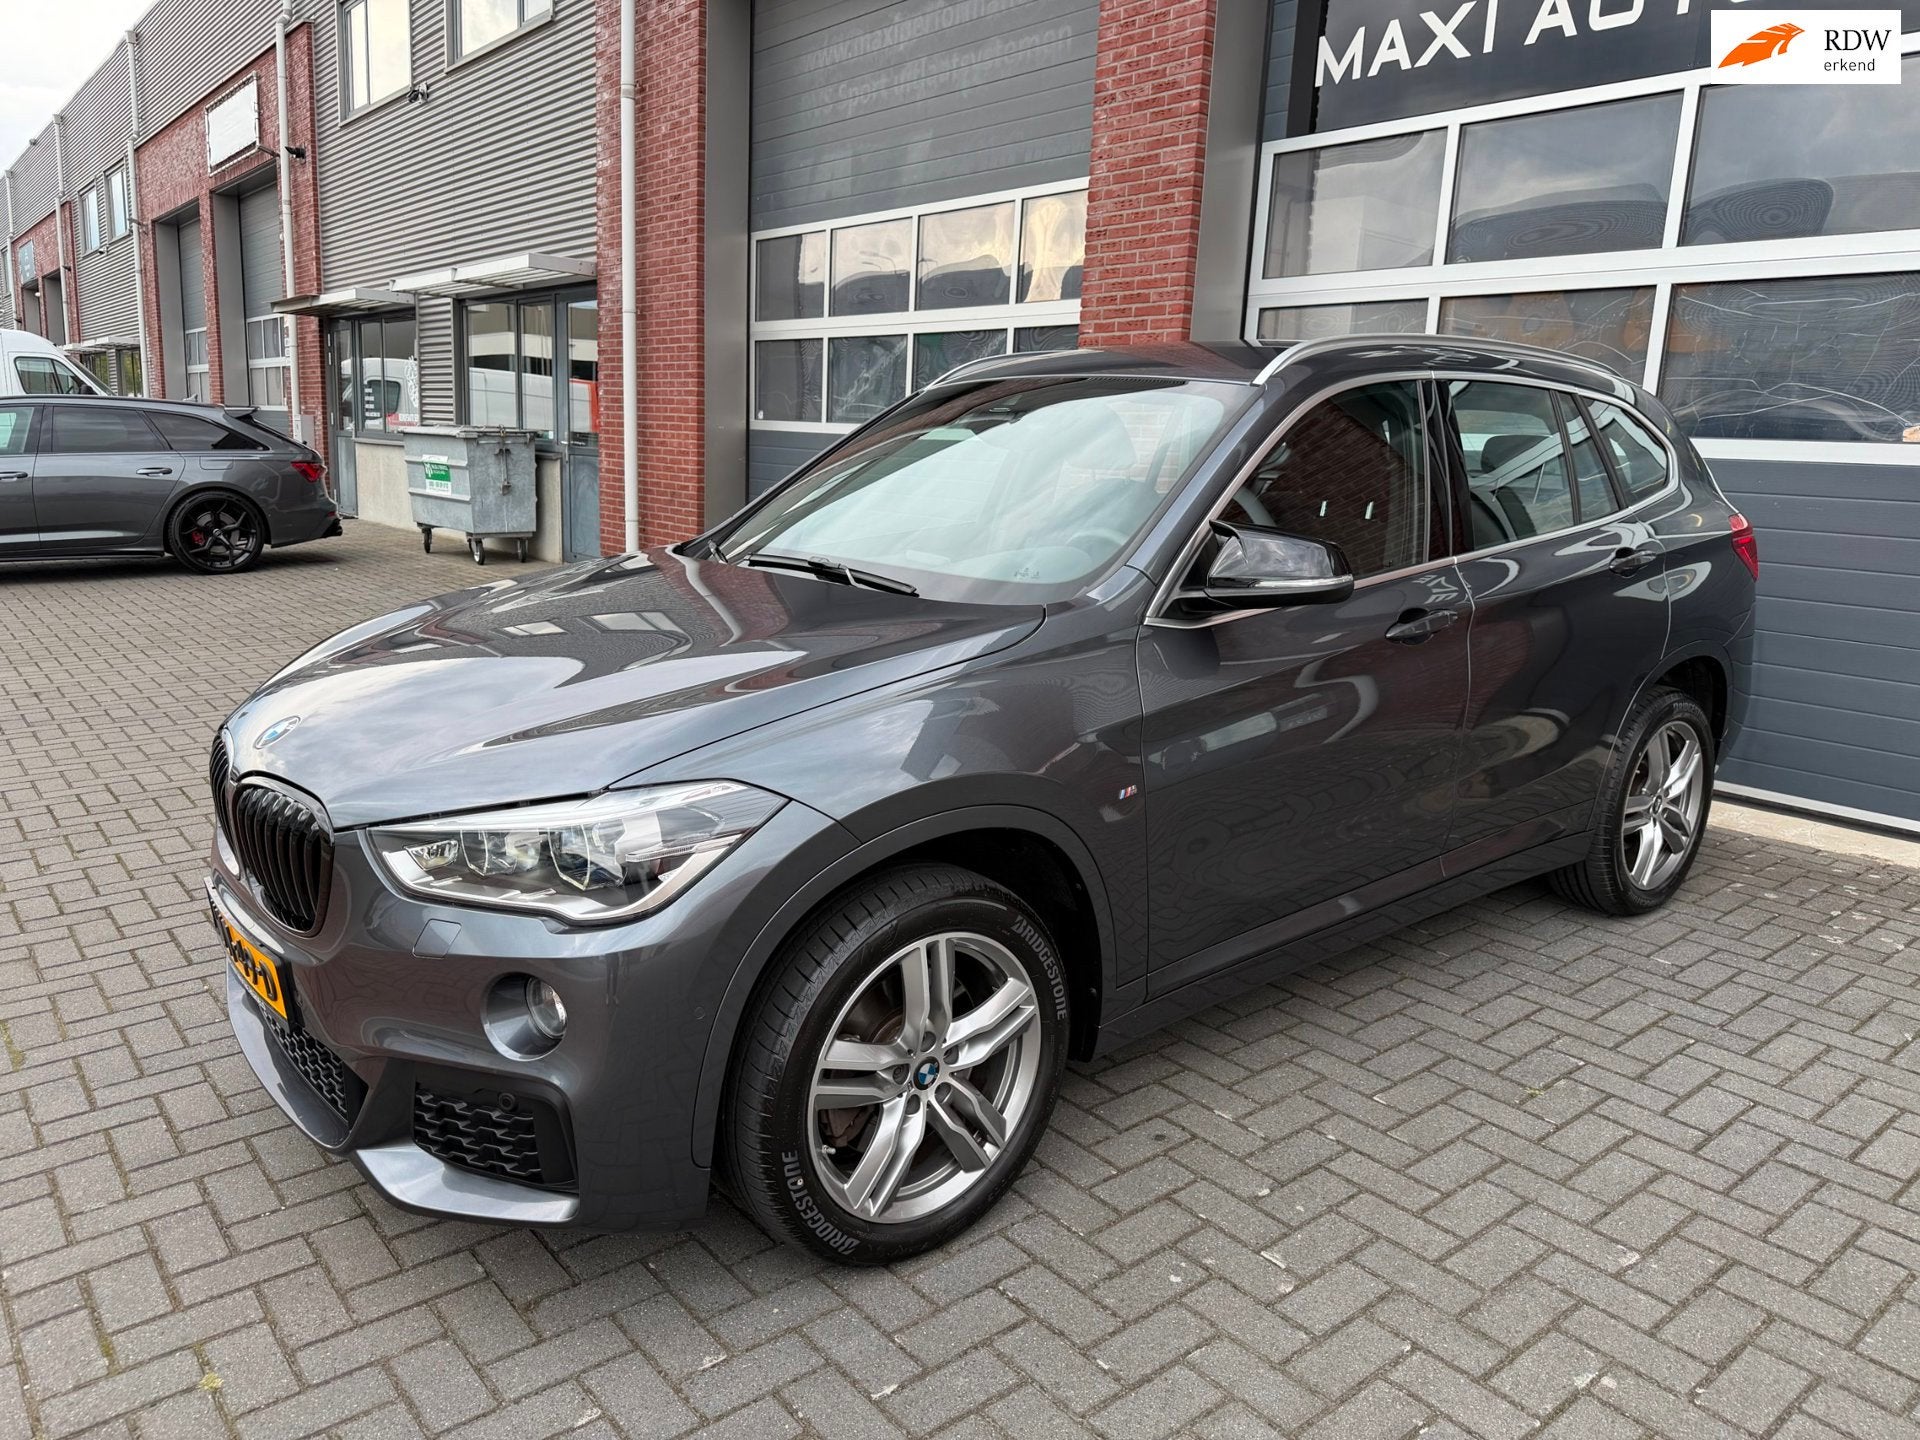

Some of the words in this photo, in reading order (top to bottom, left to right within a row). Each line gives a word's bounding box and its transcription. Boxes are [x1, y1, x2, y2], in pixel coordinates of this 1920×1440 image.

[1315, 0, 1497, 87] MAXI
[1525, 0, 1752, 45] AU
[1010, 914, 1068, 1021] BRIDGESTONE
[782, 1149, 861, 1255] BRIDGESTONE
